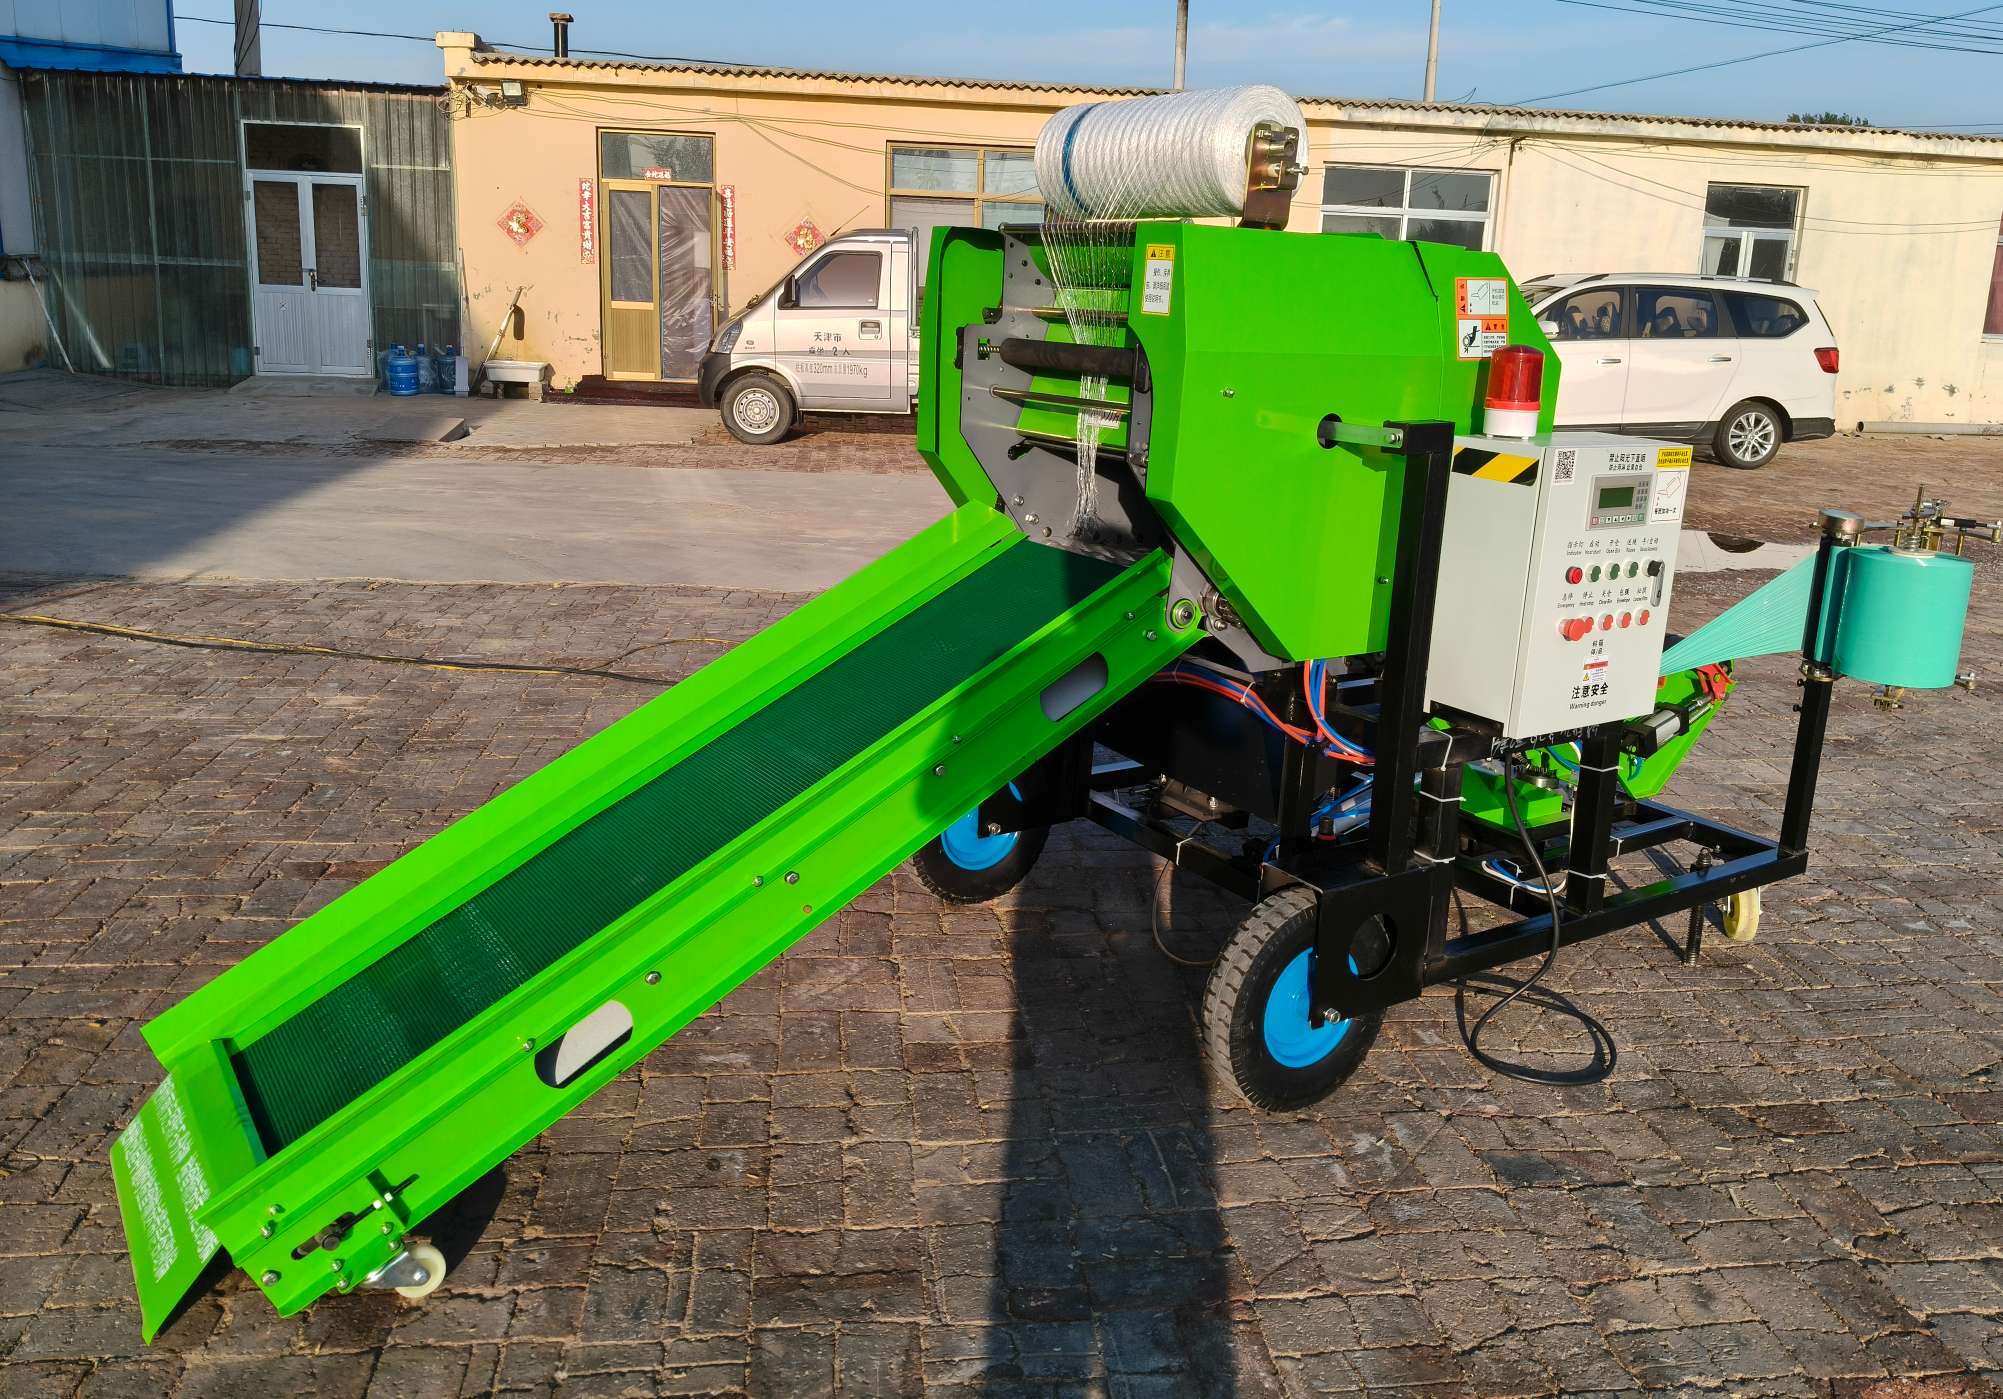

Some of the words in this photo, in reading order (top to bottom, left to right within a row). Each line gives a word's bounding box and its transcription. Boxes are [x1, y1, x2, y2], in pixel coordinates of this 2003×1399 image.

[813, 331, 842, 343] 天津市
[832, 346, 839, 356] 2
[842, 347, 851, 356] 人
[1571, 682, 1609, 700] 注意安全
[1569, 701, 1590, 710] Warning
[1590, 699, 1607, 707] danger
